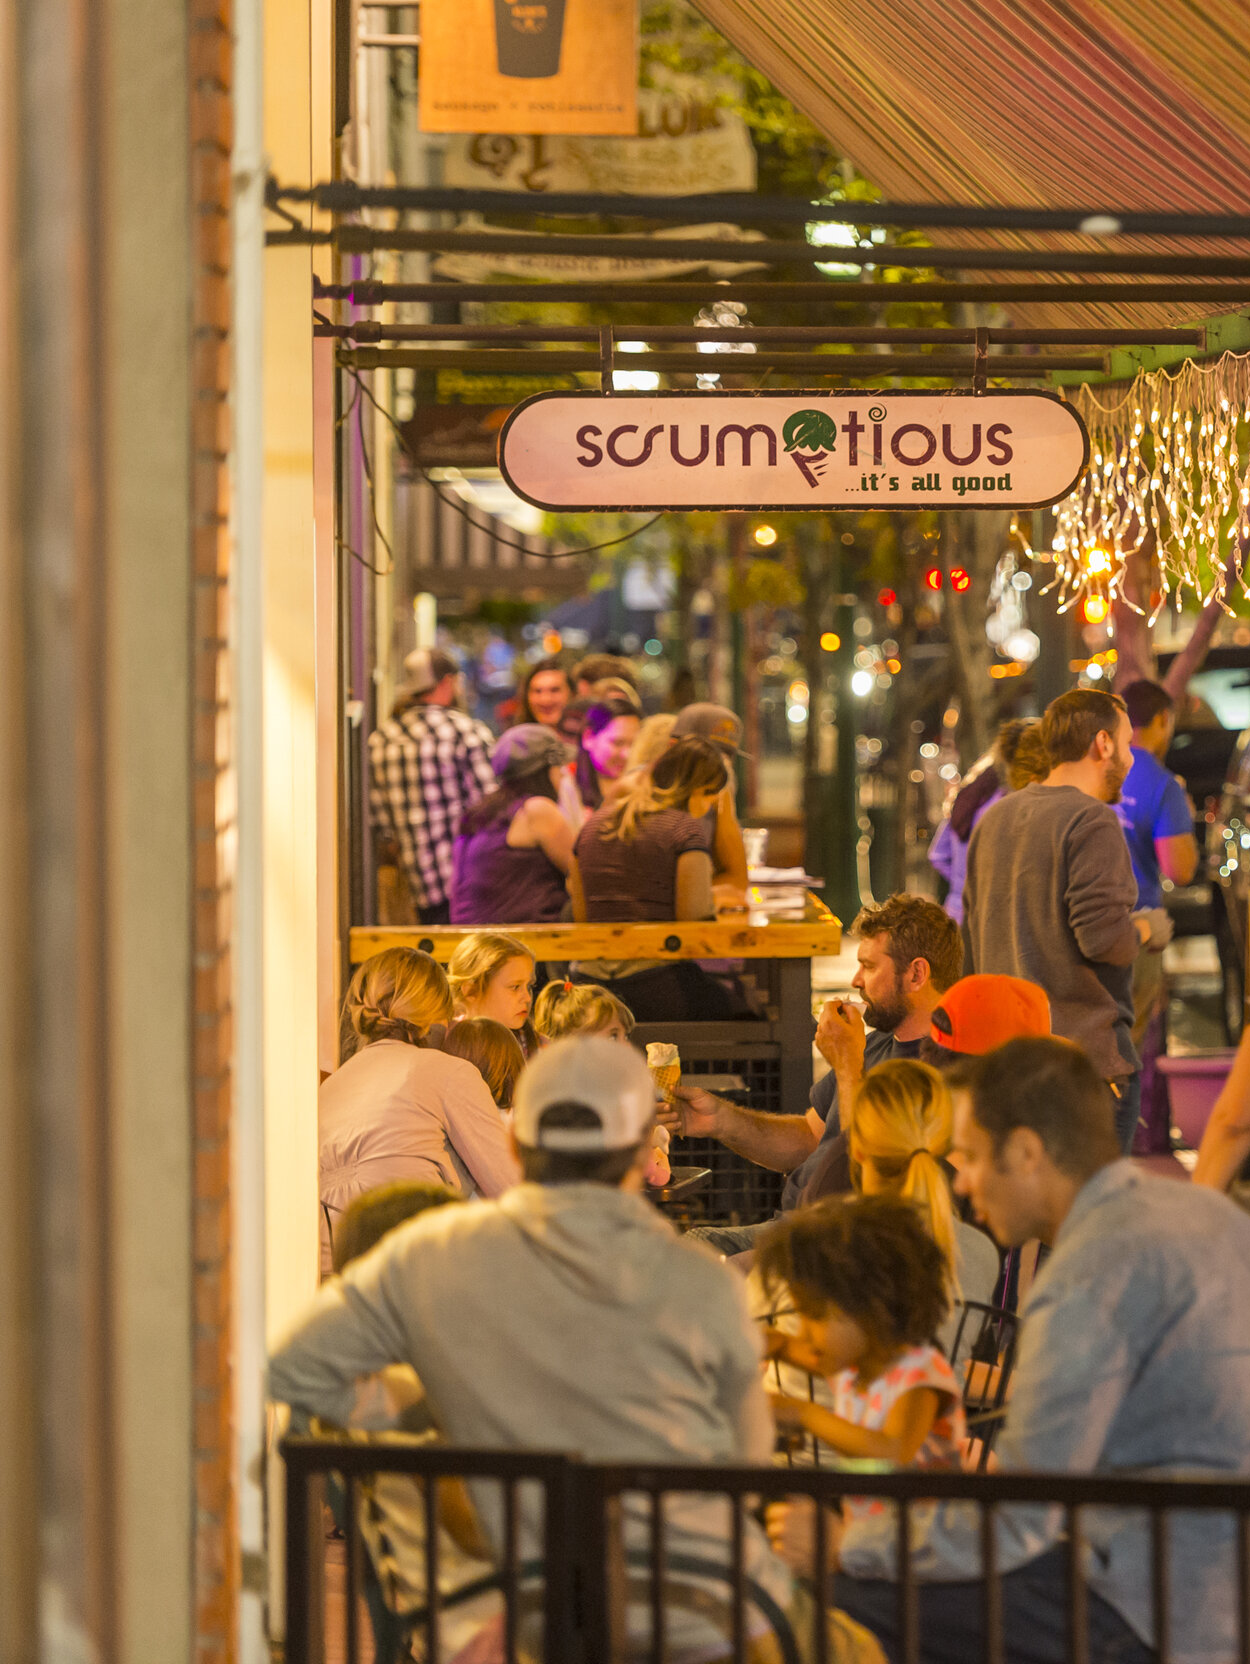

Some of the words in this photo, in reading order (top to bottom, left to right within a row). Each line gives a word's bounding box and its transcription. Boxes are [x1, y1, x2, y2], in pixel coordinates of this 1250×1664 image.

[576, 402, 1014, 489] scrumptious
[911, 472, 942, 492] all
[952, 472, 1014, 497] good
